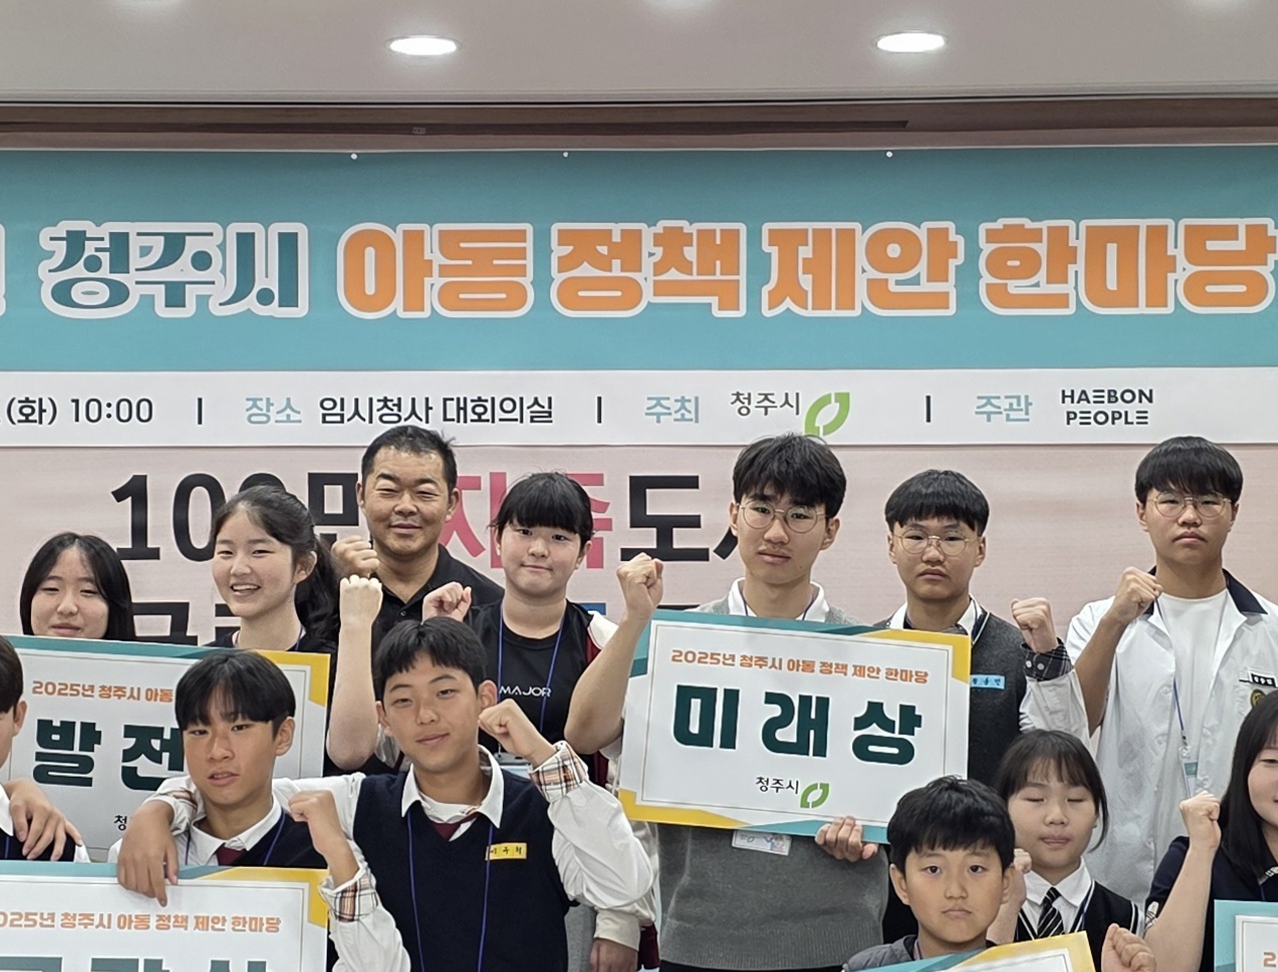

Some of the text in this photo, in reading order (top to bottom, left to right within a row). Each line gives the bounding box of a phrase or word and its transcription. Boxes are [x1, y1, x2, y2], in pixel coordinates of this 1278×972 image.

[42, 224, 308, 314] 청주시
[340, 222, 531, 316] 아동
[552, 220, 744, 316] 정책
[765, 220, 955, 314] 제안
[645, 391, 801, 424] 주최 청주시
[975, 394, 1032, 423] 주관
[1061, 388, 1154, 405] HAEBON
[70, 397, 154, 424] 10:00
[245, 396, 553, 425] 장소 임시청사 대회의실
[1066, 410, 1149, 426] PEOPLE
[671, 649, 929, 684] 2025년 청주시 아동 정책 제안 한마당
[32, 681, 174, 703] 2025년 청주시 아동
[499, 686, 552, 697] MAJOR
[755, 776, 799, 795] 청주시
[60, 912, 112, 931] 청주시
[116, 913, 151, 932] 아동
[155, 914, 189, 932] 정책
[194, 915, 227, 933] 제안
[231, 915, 281, 934] 한마당
